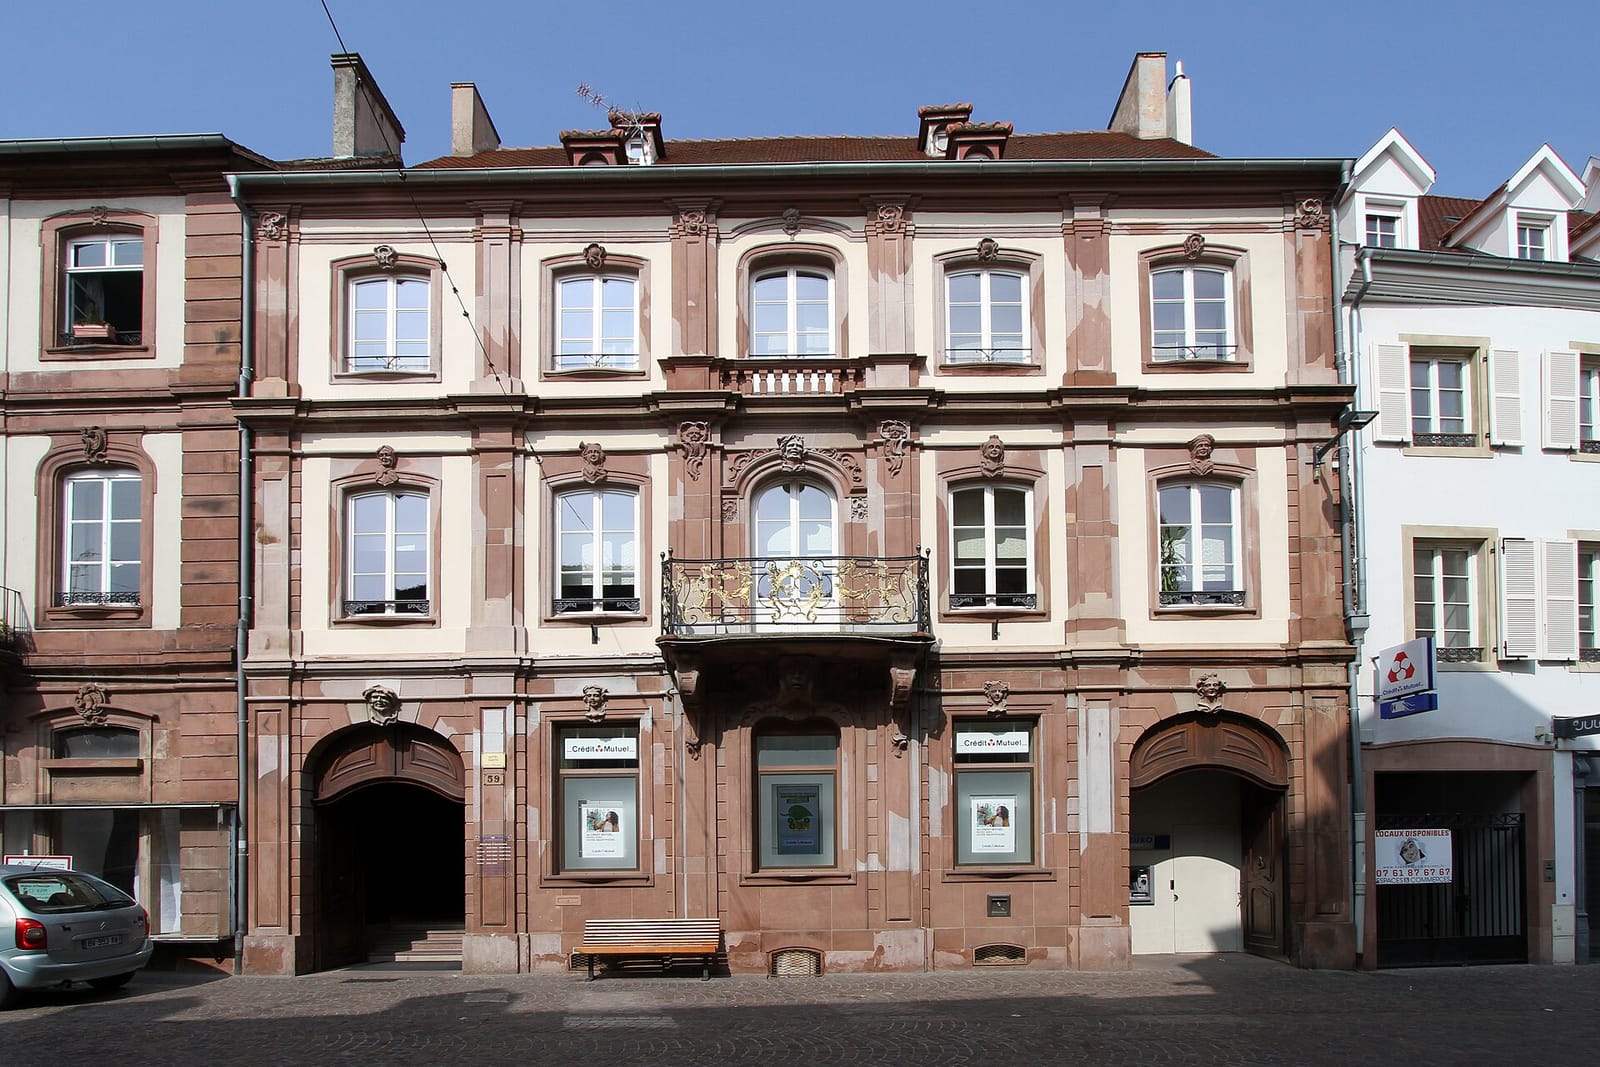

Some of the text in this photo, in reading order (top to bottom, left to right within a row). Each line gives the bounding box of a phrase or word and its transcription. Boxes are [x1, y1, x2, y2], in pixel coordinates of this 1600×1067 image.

[963, 739, 987, 747] Crédit
[571, 745, 630, 753] Crédit Mutuel
[487, 775, 500, 783] 59
[1405, 829, 1450, 837] DISPONIBLES
[1376, 868, 1450, 877] 07 61 87 67 67
